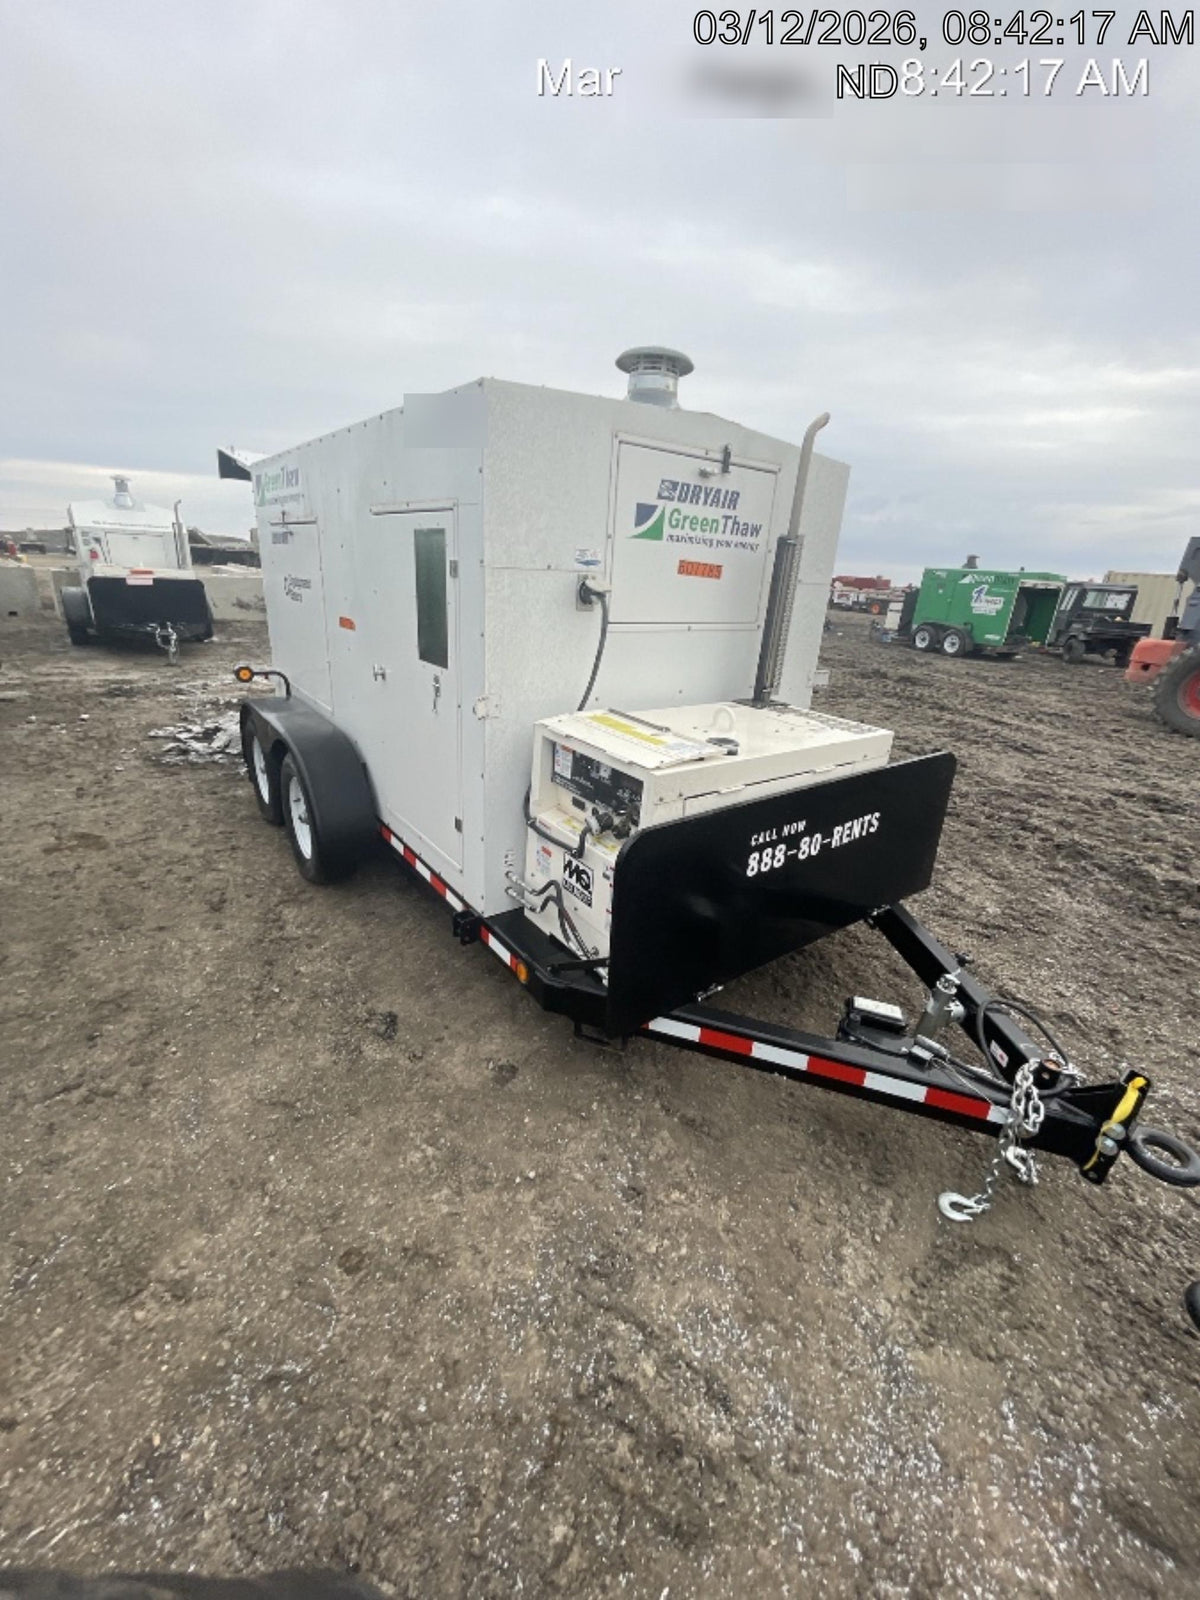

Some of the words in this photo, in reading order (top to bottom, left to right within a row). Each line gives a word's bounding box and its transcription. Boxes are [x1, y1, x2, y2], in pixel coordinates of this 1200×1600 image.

[677, 482, 740, 510] DRYAIR
[668, 507, 762, 538] GreenThaw
[746, 811, 880, 877] 888-80-RENTS
[750, 828, 777, 847] CALL
[781, 820, 807, 837] NOW
